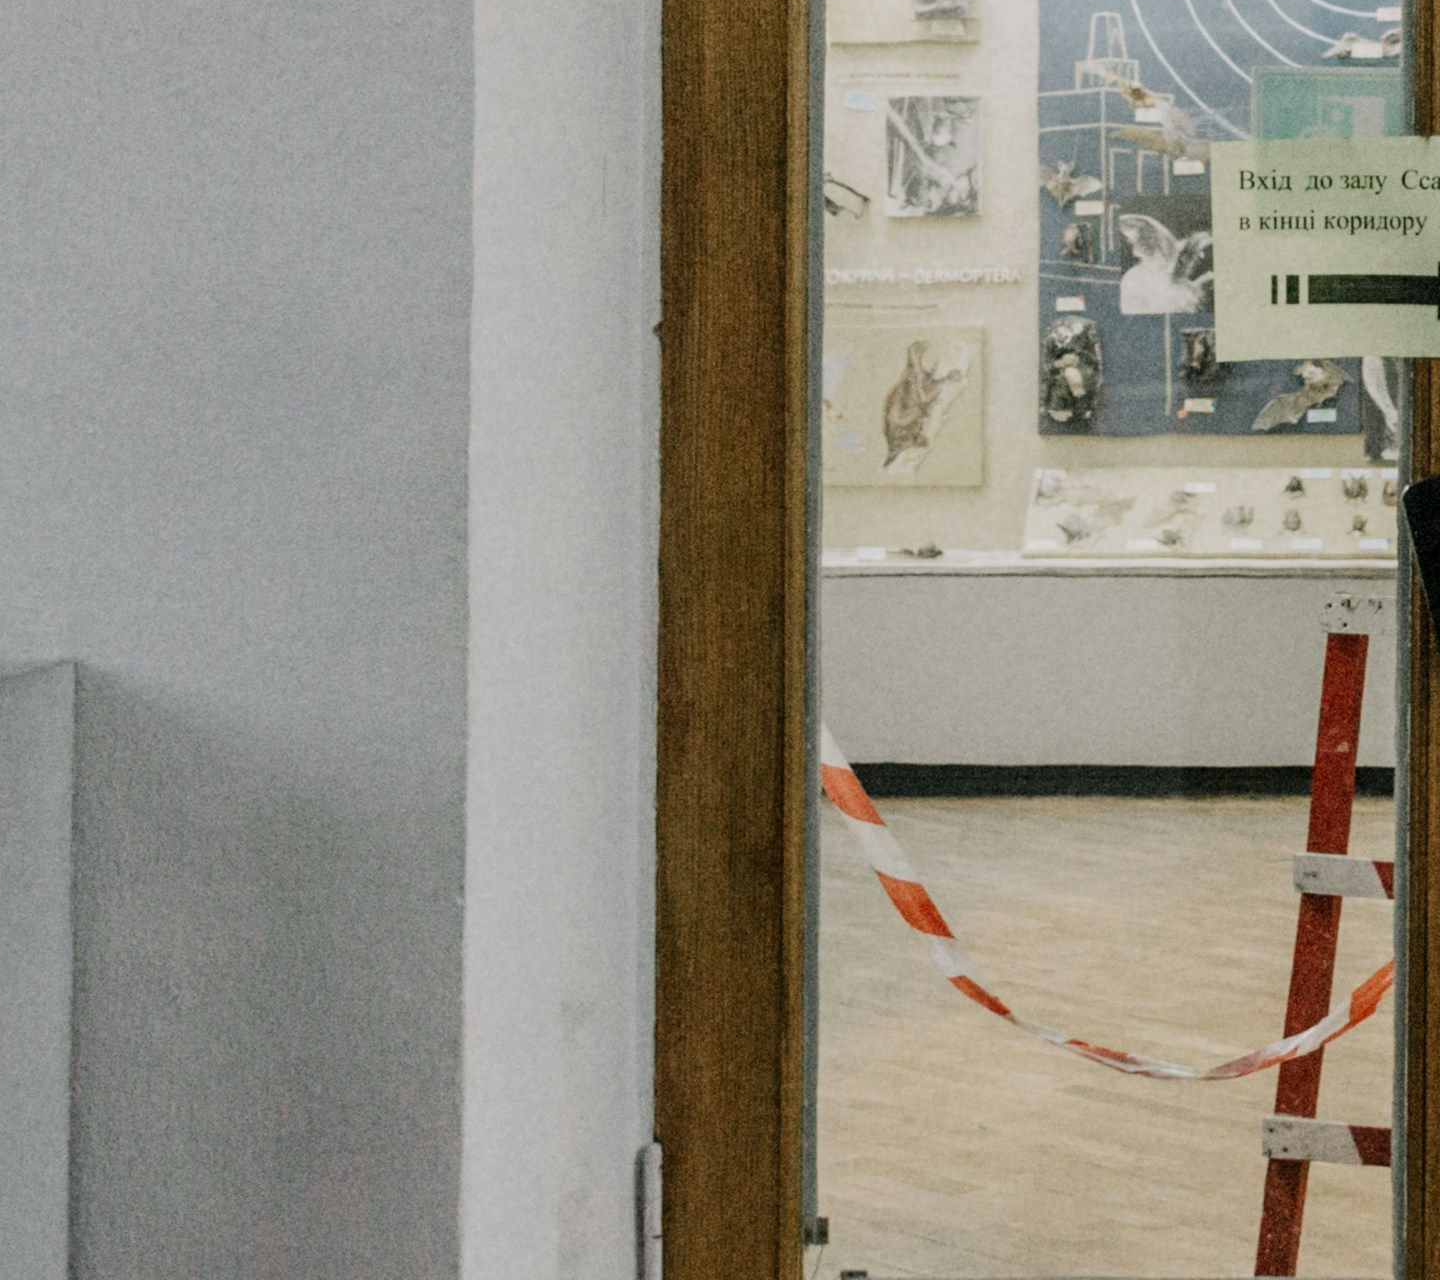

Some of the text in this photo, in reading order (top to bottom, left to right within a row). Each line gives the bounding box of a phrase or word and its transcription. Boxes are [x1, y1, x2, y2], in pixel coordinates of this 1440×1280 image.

[1239, 169, 1291, 192] Вхід
[1305, 174, 1333, 191] до
[1340, 174, 1387, 195] залу
[1239, 210, 1428, 235] в кінці коридору
